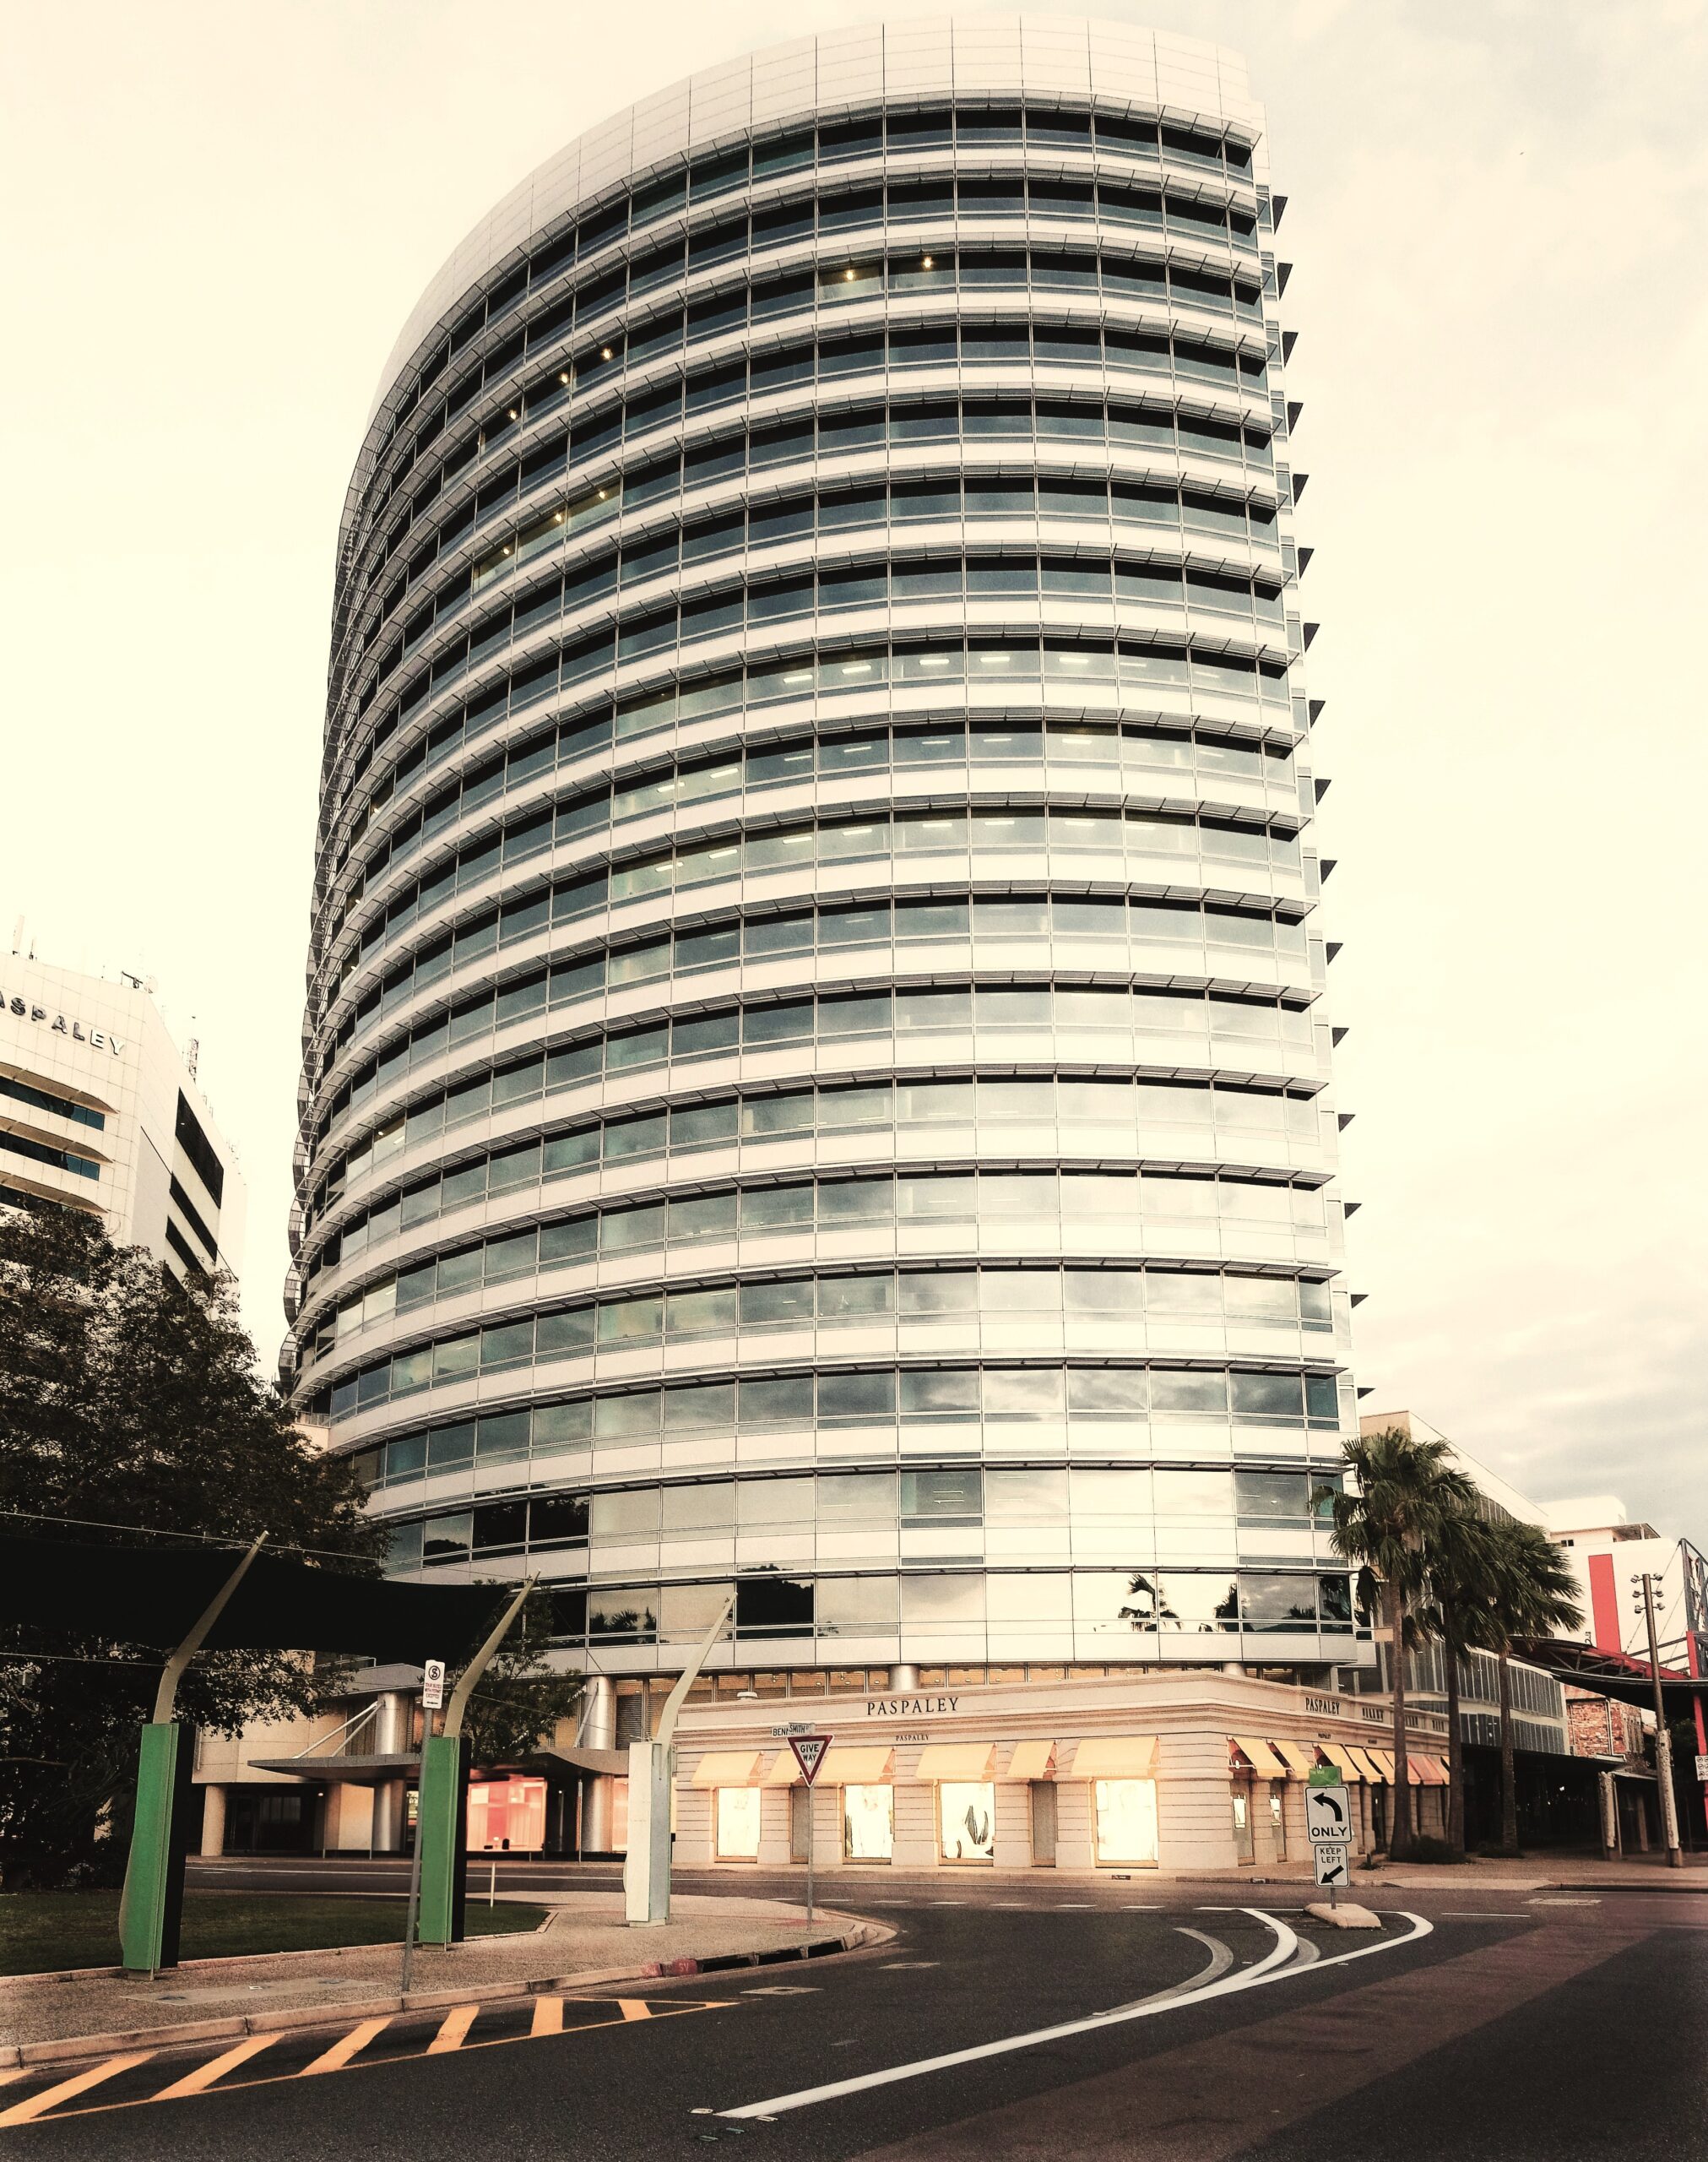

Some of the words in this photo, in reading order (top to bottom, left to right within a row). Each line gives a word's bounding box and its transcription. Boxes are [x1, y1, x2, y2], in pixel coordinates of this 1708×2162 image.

[867, 1697, 959, 1715] PASPALEY
[1304, 1697, 1340, 1715] PASPALEY
[789, 1724, 805, 1734] SMITH
[800, 1743, 820, 1753] GIVE
[802, 1753, 816, 1762] WAY
[1311, 1826, 1347, 1837] ONLY
[1320, 1846, 1342, 1855] KEEP
